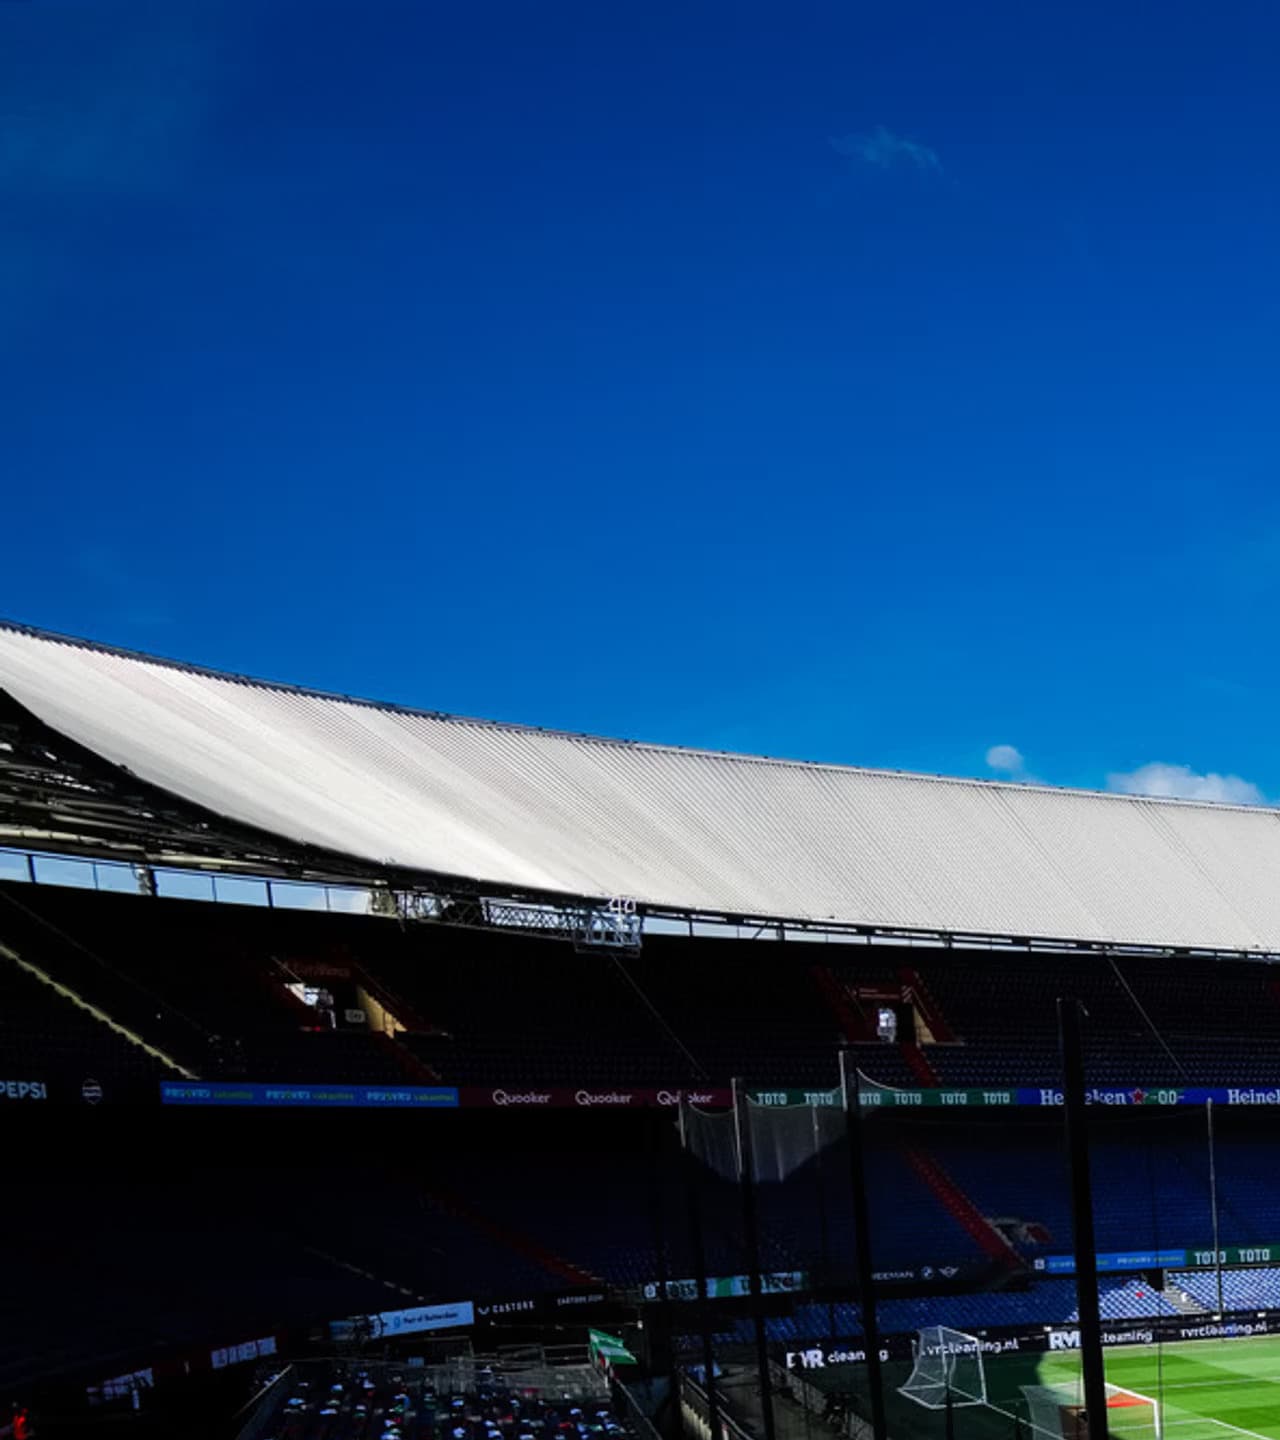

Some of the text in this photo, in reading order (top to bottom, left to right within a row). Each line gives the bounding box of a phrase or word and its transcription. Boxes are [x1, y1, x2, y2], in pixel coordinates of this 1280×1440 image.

[0, 1081, 48, 1100] PEPSI
[492, 1089, 551, 1106] Quooker
[575, 1089, 632, 1106] Quooker
[1040, 1089, 1127, 1105] Heeken
[757, 1092, 788, 1105] TOTO
[803, 1092, 833, 1105] TOTO
[859, 1092, 881, 1105] OTO
[894, 1092, 922, 1105] TOTO
[940, 1092, 968, 1105] TOTO
[982, 1092, 1010, 1105] TOTO
[1195, 1250, 1227, 1265] TOTO
[1238, 1248, 1270, 1262] TOTO
[1180, 1321, 1267, 1338] rvrcleaning.nl
[828, 1349, 889, 1364] cleang
